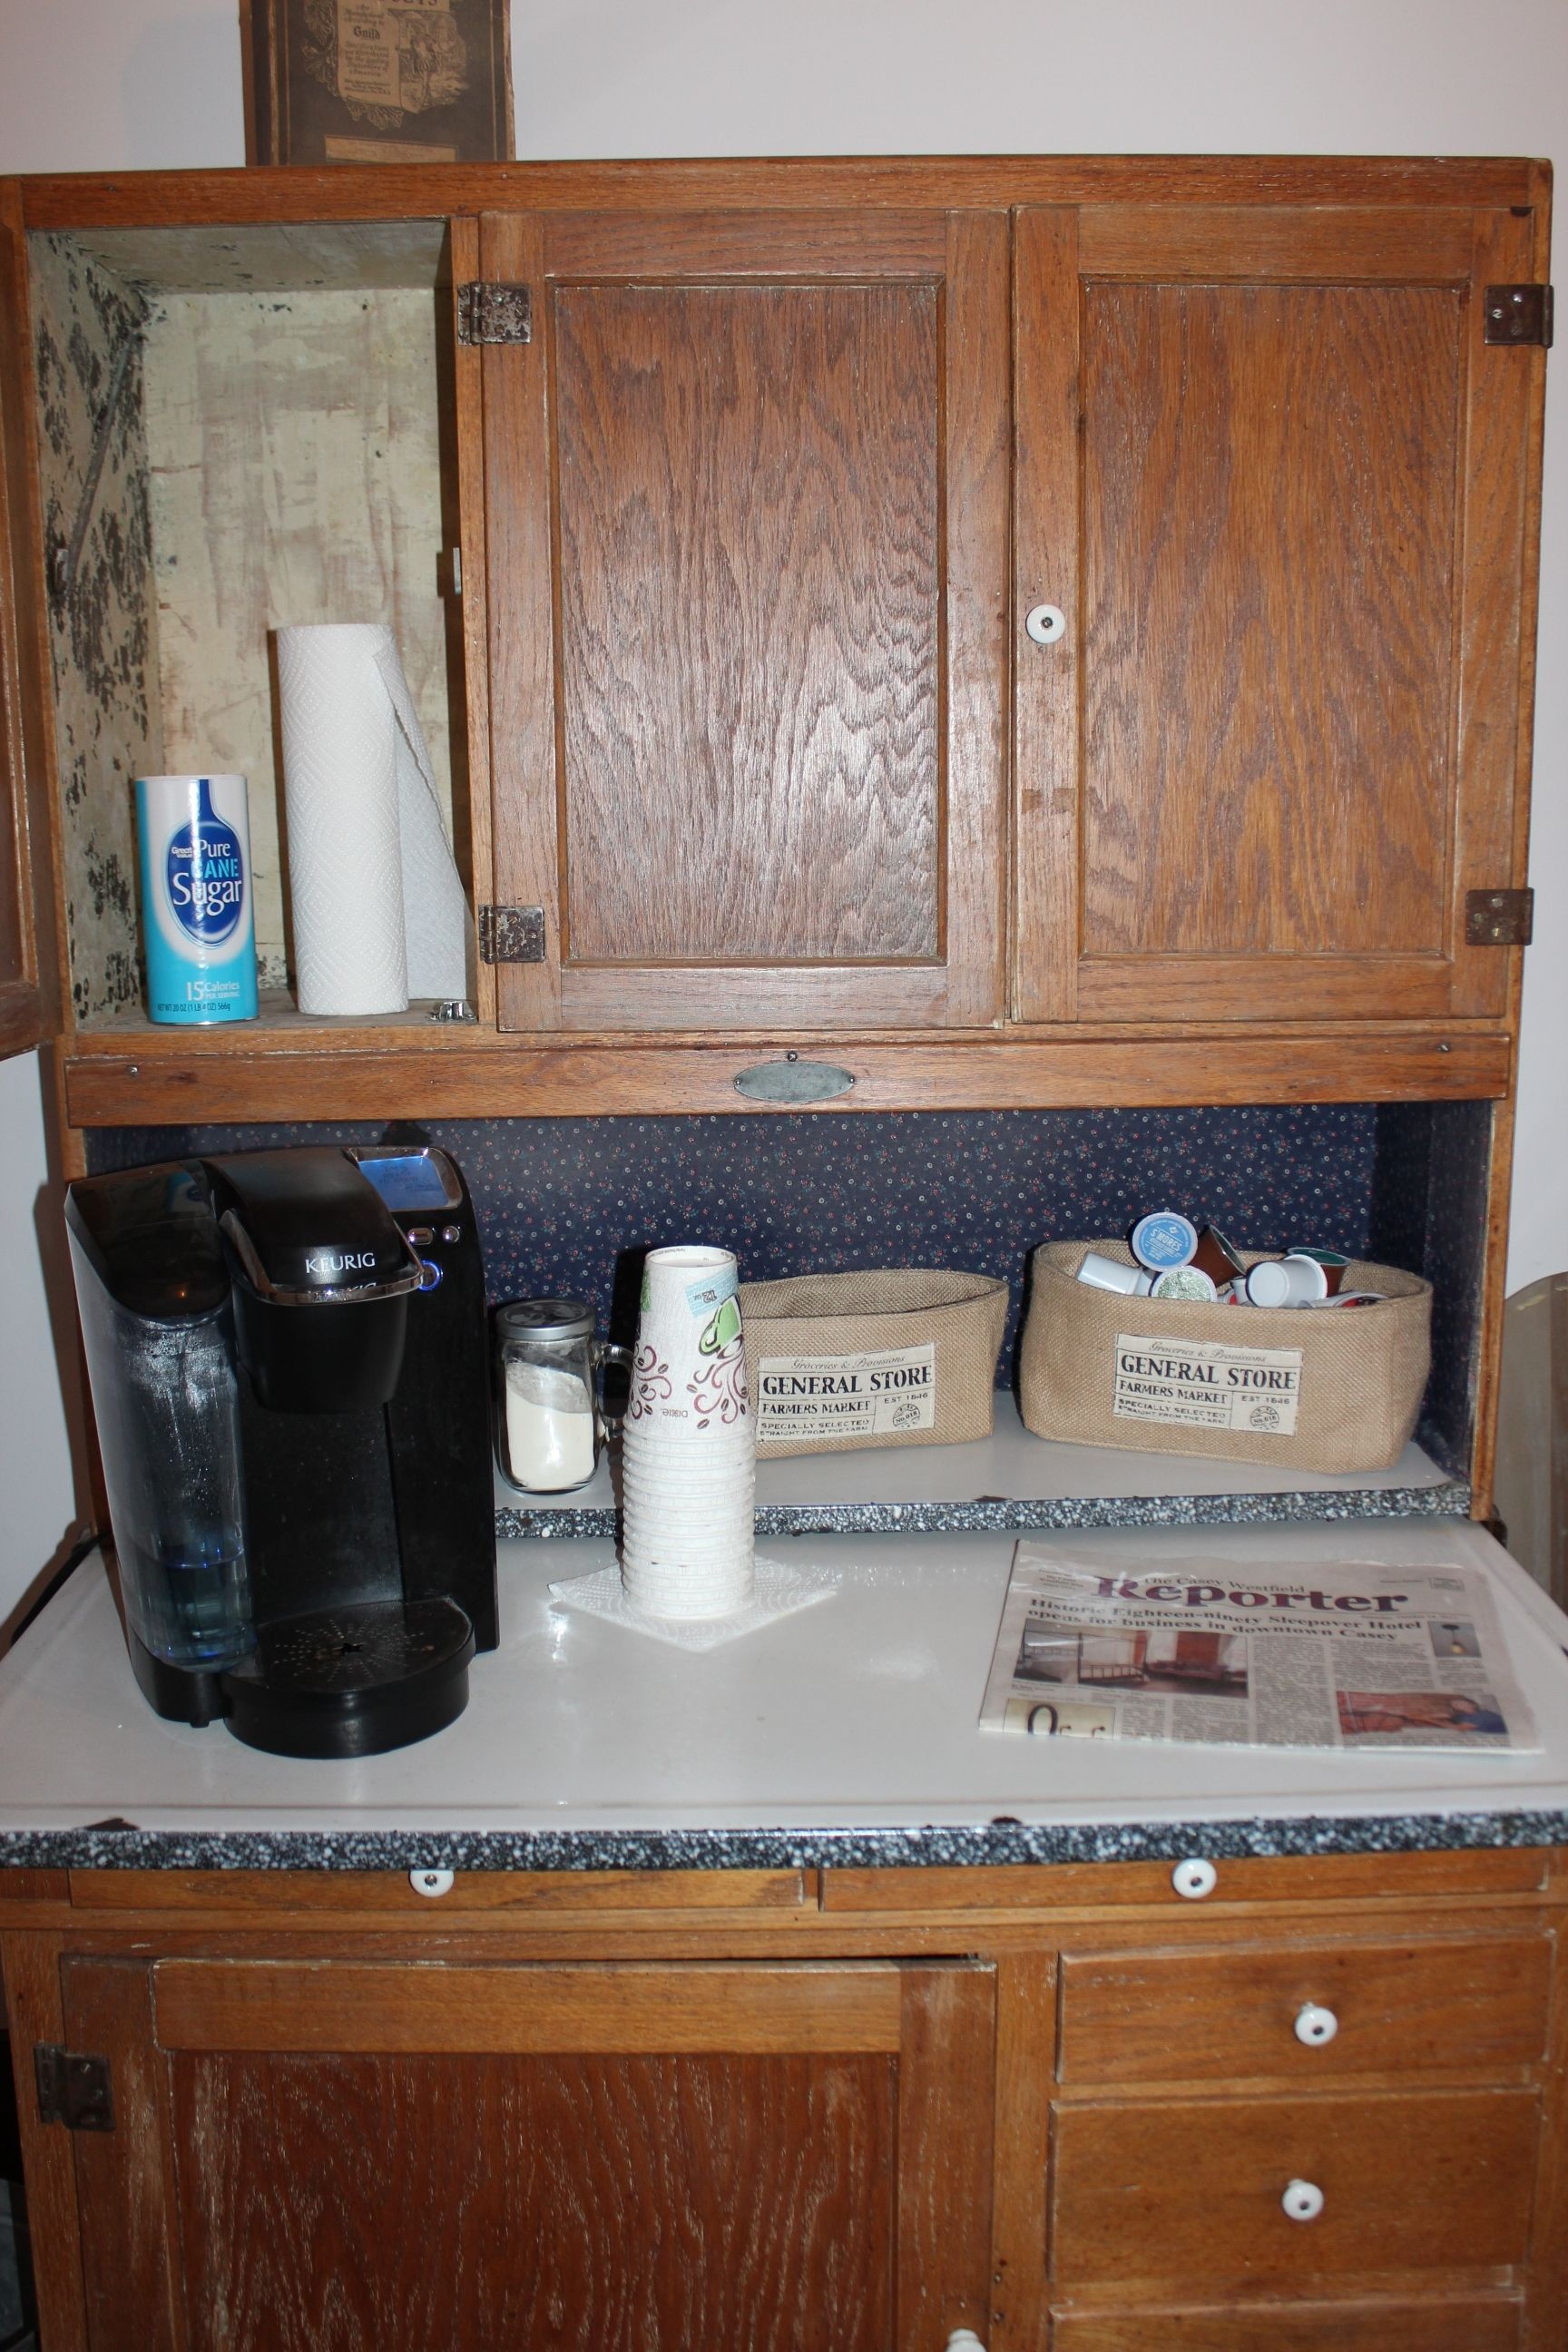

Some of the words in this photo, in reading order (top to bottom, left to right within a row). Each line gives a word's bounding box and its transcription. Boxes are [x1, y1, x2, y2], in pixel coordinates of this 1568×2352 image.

[198, 838, 231, 858] Pure
[191, 858, 239, 878] CANE
[172, 872, 242, 916] Sugar
[186, 980, 204, 1001] 15
[204, 980, 240, 992] Calories
[305, 1252, 376, 1274] KEURIG
[701, 1289, 718, 1304] 12
[790, 1357, 838, 1370] Groceries
[840, 1360, 851, 1369] &
[852, 1355, 906, 1368] Provisions
[1149, 1341, 1194, 1357] Groceries
[1197, 1350, 1207, 1358] &
[1210, 1349, 1267, 1363] Provisions
[762, 1375, 862, 1396] GENERAL
[869, 1365, 933, 1392] STORE
[1121, 1354, 1220, 1385] GENERAL
[1227, 1367, 1297, 1390] STORE
[1120, 1379, 1174, 1397] FARMERS
[1177, 1387, 1228, 1405] MARKET
[762, 1403, 818, 1415] FARMERS
[822, 1400, 871, 1414] MARKET
[1118, 1398, 1171, 1412] SPECIALLY
[1174, 1407, 1226, 1418] SELECTED
[760, 1422, 816, 1430] SPECIALLY
[818, 1418, 870, 1428] SELECTED
[1093, 1574, 1408, 1612] Reporter
[1176, 1577, 1224, 1587] Casey
[1229, 1580, 1305, 1592] Westfield
[1031, 1598, 1106, 1614] Historic
[1112, 1606, 1262, 1625] Eighteen-ninety
[1269, 1615, 1365, 1632] Sleepover
[1369, 1621, 1422, 1631] Hotel
[1089, 1616, 1117, 1625] for
[1122, 1618, 1202, 1629] business
[1208, 1620, 1226, 1631] in
[1232, 1624, 1332, 1637] downtown
[1338, 1629, 1397, 1642] Casey
